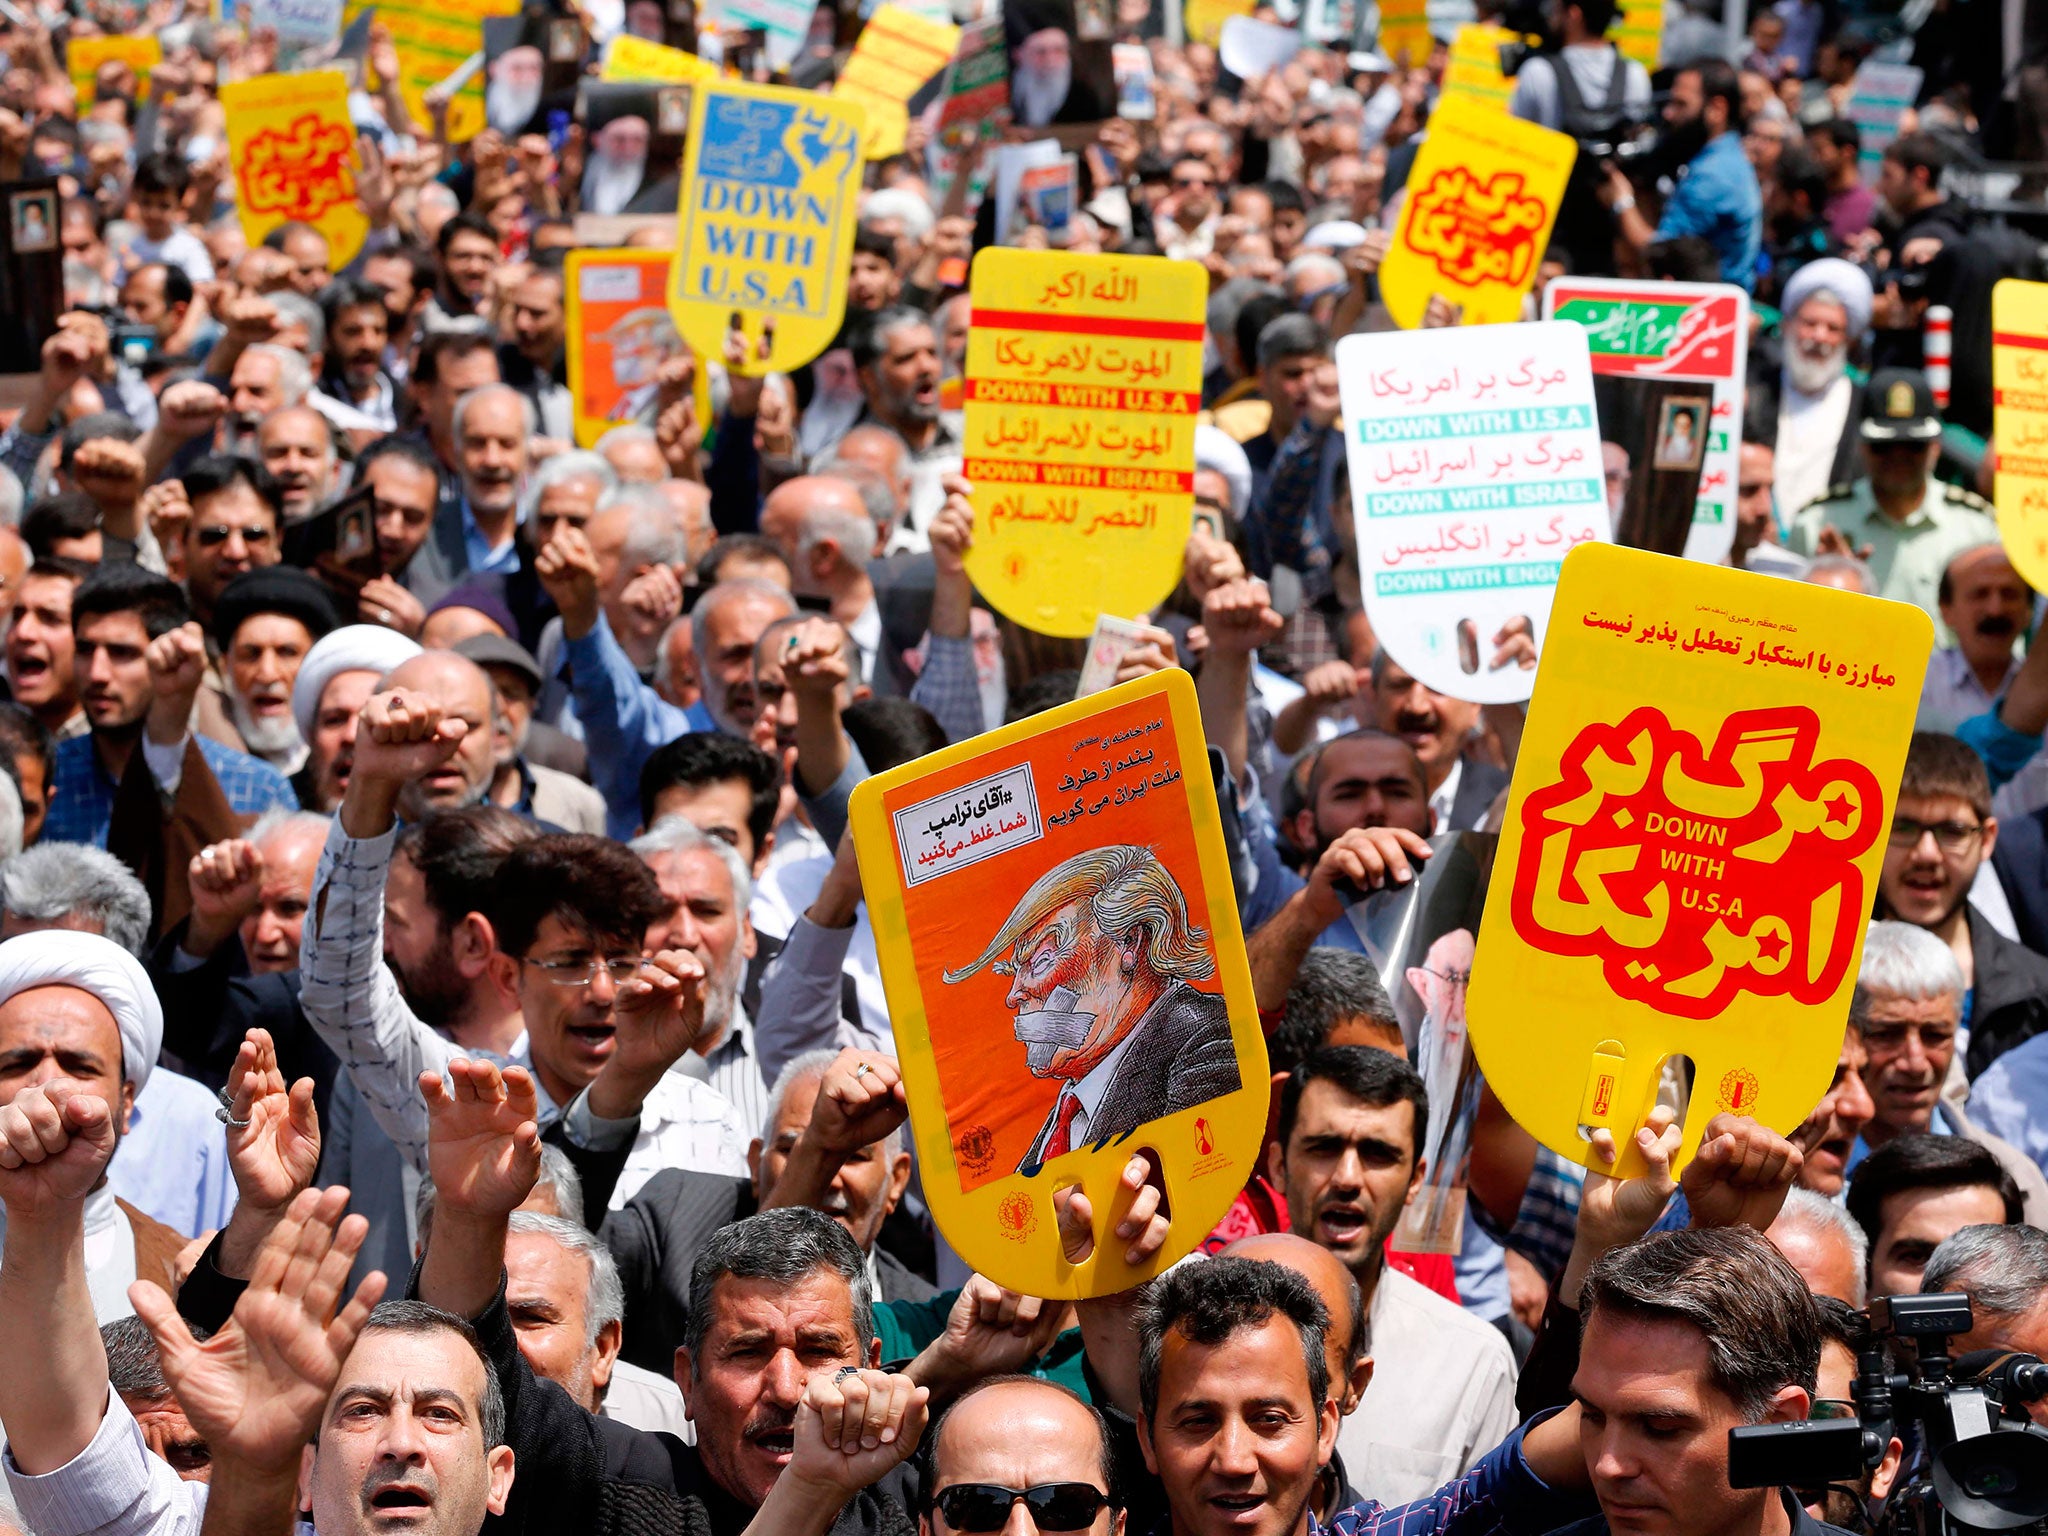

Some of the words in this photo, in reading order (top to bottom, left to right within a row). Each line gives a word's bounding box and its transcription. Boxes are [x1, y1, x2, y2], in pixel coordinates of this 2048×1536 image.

[701, 181, 831, 226] DOWN
[705, 223, 815, 267] WITH
[701, 266, 807, 310] U.S.A
[1097, 349, 1171, 382] الموت
[1507, 358, 1566, 394] مرگ
[976, 381, 1049, 402] DOWN
[1055, 385, 1119, 408] WITH
[1124, 389, 1189, 414] U.S.A
[1473, 376, 1496, 399] بر
[1365, 419, 1441, 441] DOWN
[1449, 412, 1512, 436] WITH
[1518, 407, 1585, 431] U.S.A
[1098, 426, 1172, 460] الموت
[1524, 436, 1584, 472] مرگ
[967, 459, 1037, 481] DOWN
[1042, 465, 1100, 486] WITH
[1105, 468, 1184, 492] ISRAEL
[1488, 455, 1513, 478] بر
[1372, 493, 1443, 515] DOWN
[1449, 487, 1508, 510] WITH
[1514, 481, 1595, 505] ISRAEL
[1382, 521, 1490, 565] انگلیس
[1499, 533, 1526, 558] بر
[1377, 572, 1443, 592] DOWN
[1447, 568, 1501, 588] WITH
[1583, 611, 1633, 638] نیست
[1635, 621, 1678, 650] پذیر
[1681, 628, 1743, 655] تعطیل
[1743, 641, 1814, 670] استکبار
[1818, 653, 1832, 679] با
[1836, 663, 1896, 690] مبارزه
[1112, 726, 1144, 744] خامنه
[1144, 718, 1164, 736] امام
[1101, 758, 1112, 781] از
[1115, 748, 1155, 772] بنده
[1057, 768, 1098, 792] طرف
[1114, 776, 1149, 806] ایران
[1542, 727, 1654, 830] بر
[1088, 794, 1110, 816] می
[1663, 727, 1863, 865] مرگ
[1645, 811, 1728, 847] DOWN
[1659, 848, 1726, 881] WITH
[1531, 827, 1842, 999] امریکا
[1680, 886, 1744, 919] U.S.A
